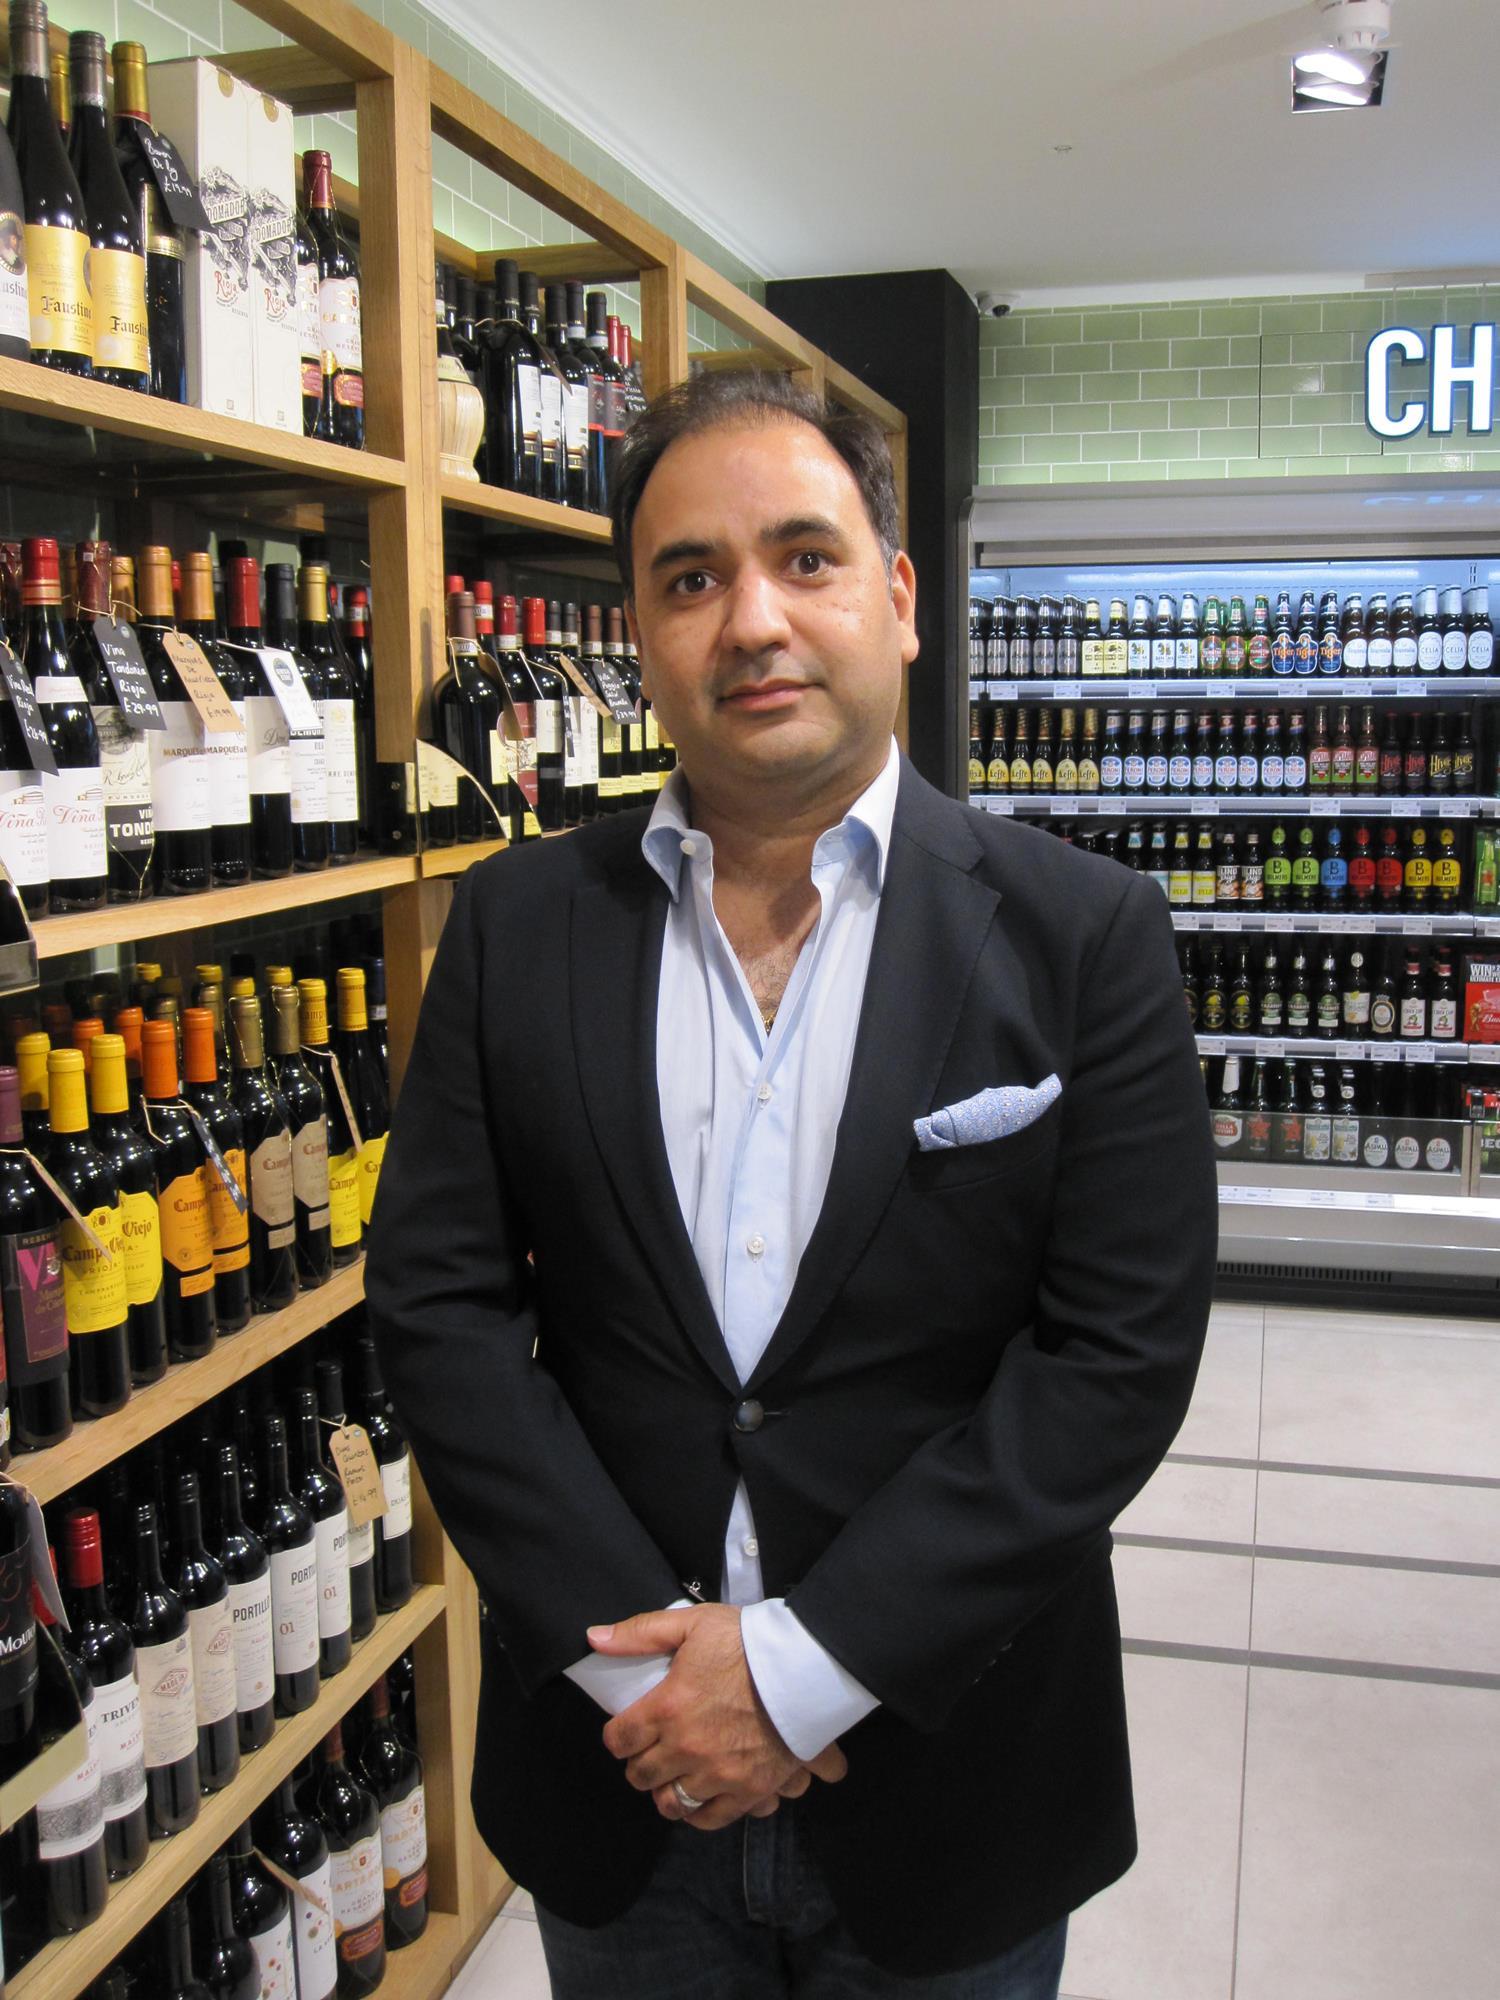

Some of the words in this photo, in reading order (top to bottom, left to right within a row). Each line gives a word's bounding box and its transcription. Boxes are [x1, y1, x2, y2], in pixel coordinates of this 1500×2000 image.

[1366, 323, 1495, 440] CH
[1273, 647, 1294, 660] Tiger
[1296, 647, 1317, 660] Tiger
[1320, 647, 1341, 660] Tiger
[1421, 647, 1439, 655] CELIA
[1446, 647, 1464, 655] CELIA
[1471, 646, 1489, 655] CELIA
[1470, 964, 1491, 977] WIN
